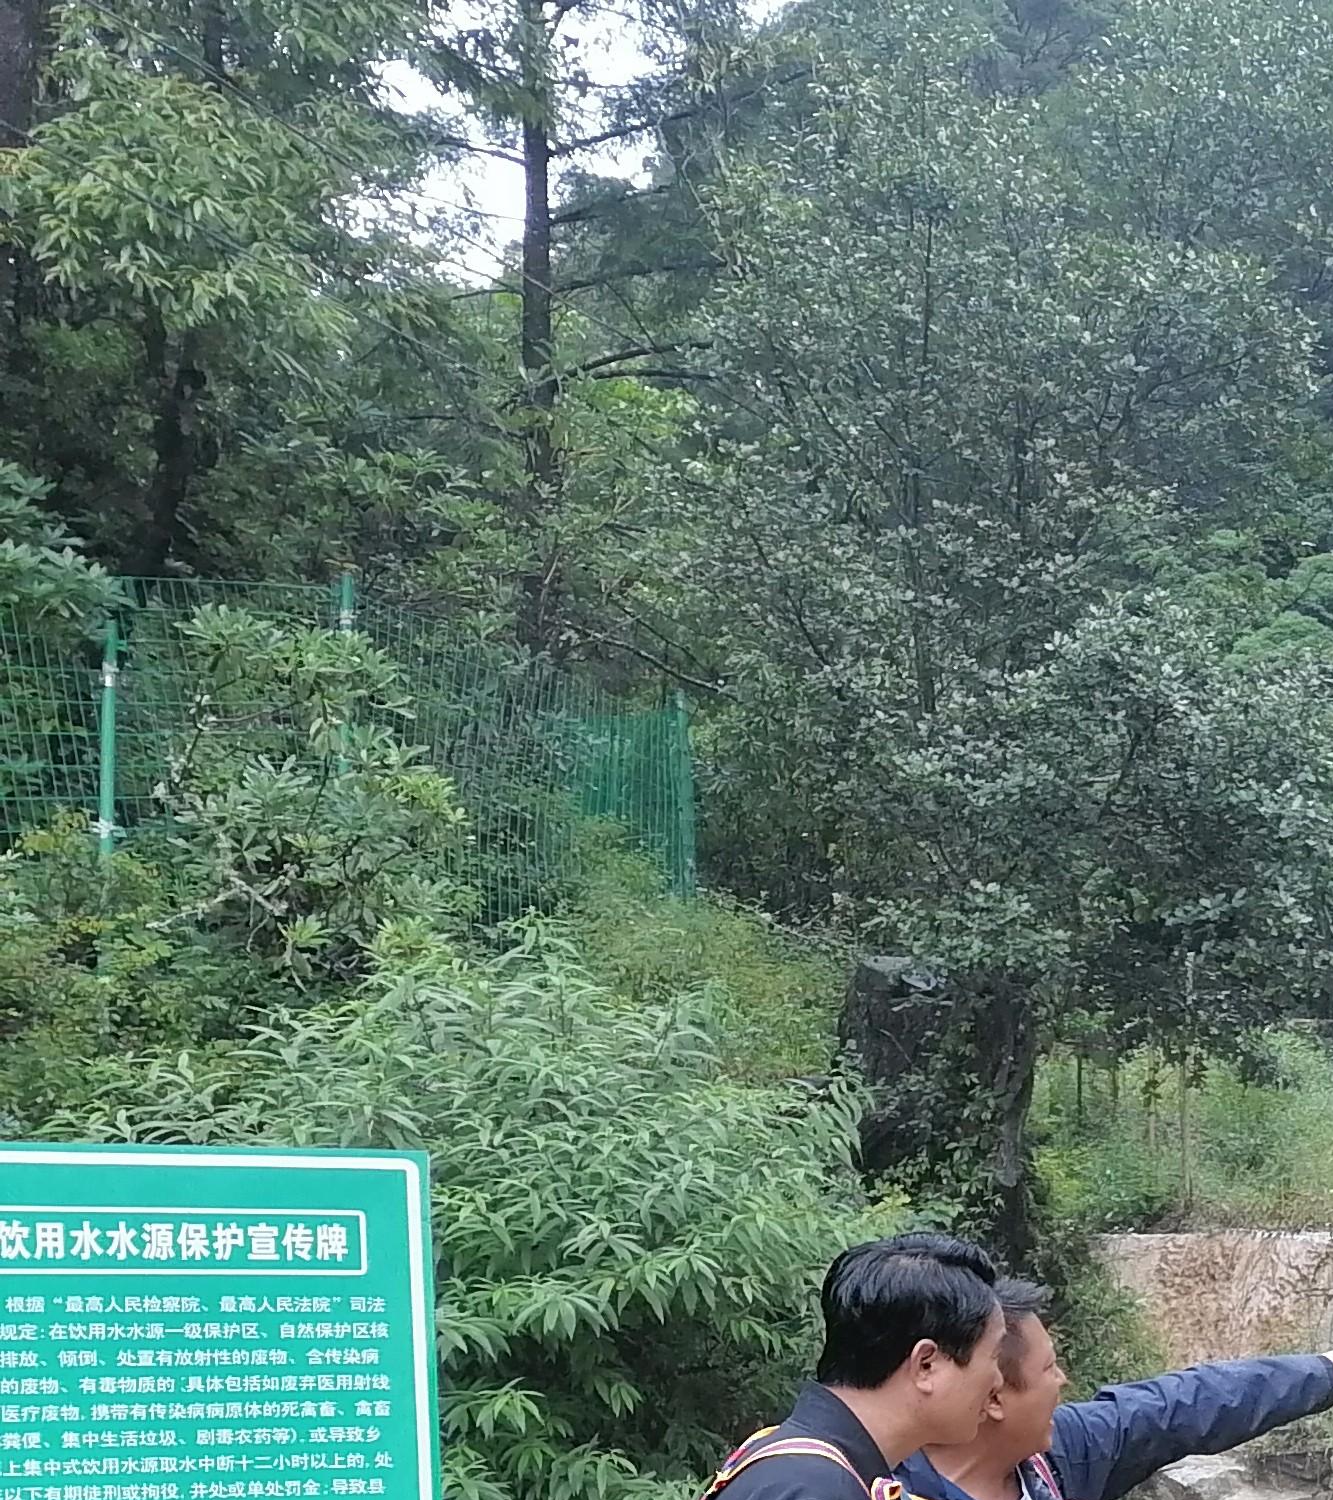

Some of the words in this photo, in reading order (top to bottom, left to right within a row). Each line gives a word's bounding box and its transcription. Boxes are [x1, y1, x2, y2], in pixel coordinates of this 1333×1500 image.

[0, 1220, 349, 1263] 饮用水水源保护宣传牌
